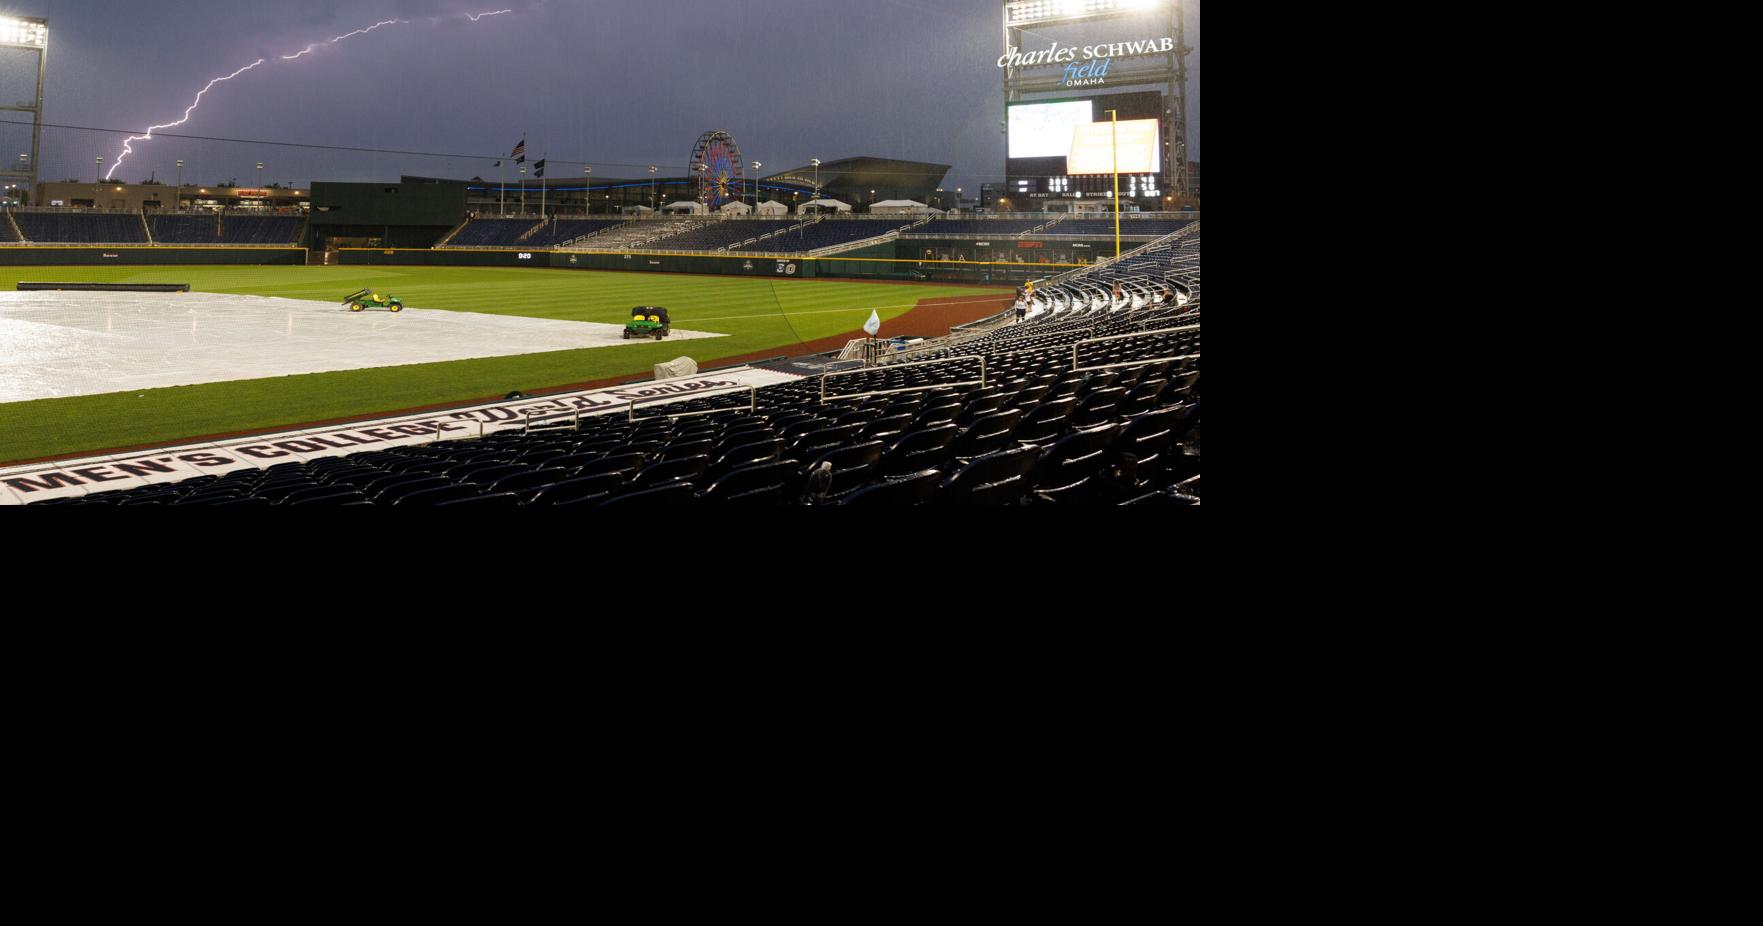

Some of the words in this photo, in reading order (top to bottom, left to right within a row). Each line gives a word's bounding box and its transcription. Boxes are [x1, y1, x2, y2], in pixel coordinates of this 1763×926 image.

[997, 42, 1078, 68] charles
[1082, 37, 1174, 59] SCHWAB
[1060, 58, 1111, 84] field
[1066, 77, 1105, 87] OMAHA
[3, 452, 235, 493] MEN'S
[235, 420, 468, 459] COLLEGE
[450, 396, 612, 423] World
